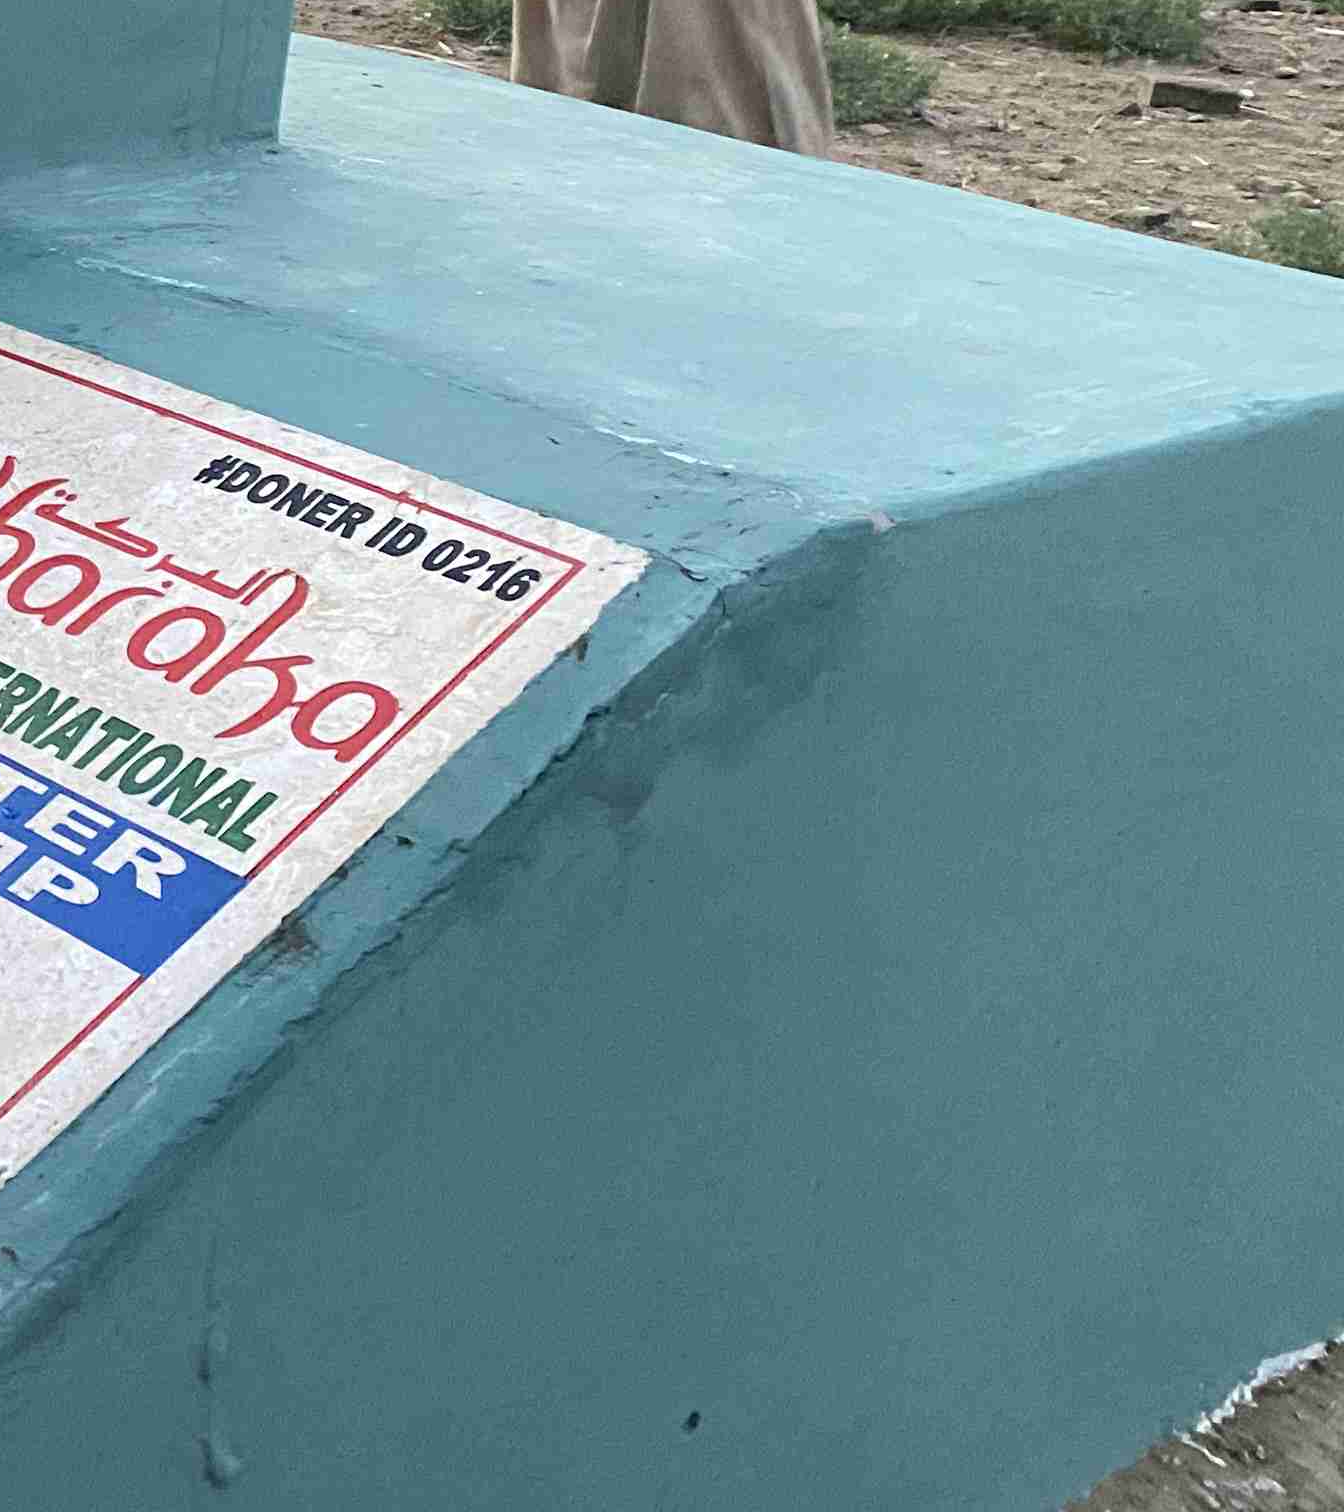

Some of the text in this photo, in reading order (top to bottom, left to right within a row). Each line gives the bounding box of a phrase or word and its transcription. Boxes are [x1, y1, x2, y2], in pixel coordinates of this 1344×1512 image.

[34, 488, 284, 606] البركة
[193, 454, 542, 602] #DONER ID 0216
